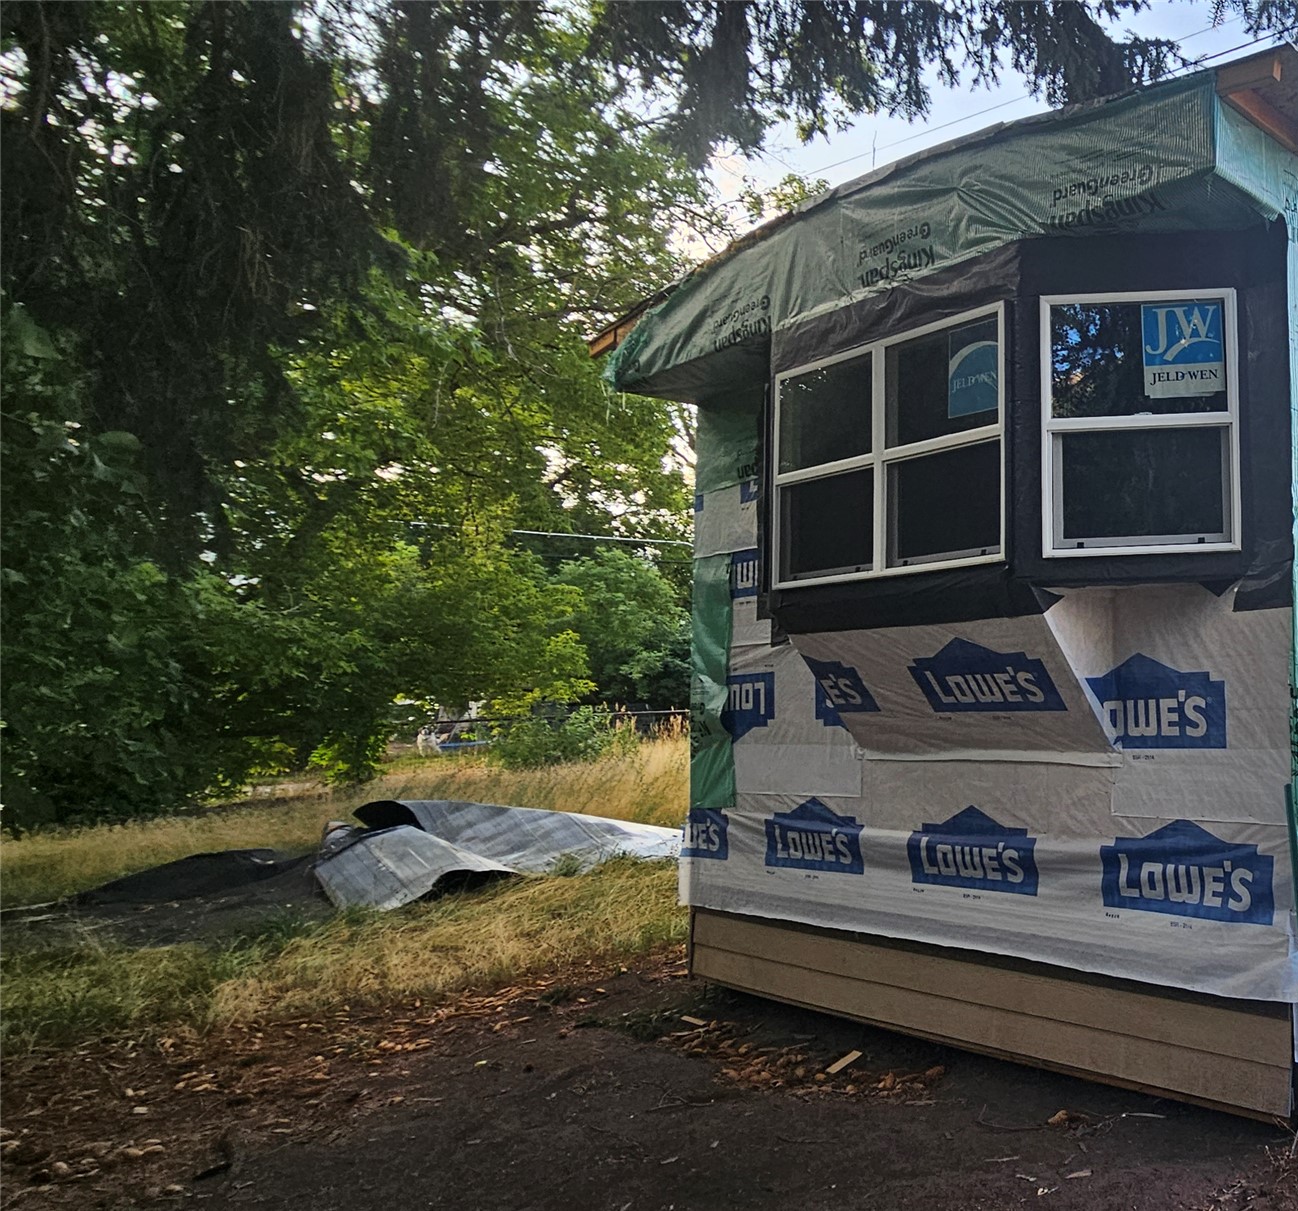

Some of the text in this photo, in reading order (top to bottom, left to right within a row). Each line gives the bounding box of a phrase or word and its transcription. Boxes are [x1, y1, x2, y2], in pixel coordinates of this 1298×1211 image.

[1051, 166, 1154, 209] GreenGuard
[1050, 194, 1165, 233] Kingspan
[858, 222, 932, 266] GreenGuard
[857, 247, 937, 289] Kingspan
[1145, 306, 1217, 355] JW
[924, 666, 1045, 704] LOWE'S
[1103, 690, 1208, 738] OWE'S
[773, 824, 852, 865] LOWE'S
[920, 836, 1025, 884] LOWE'S
[1118, 853, 1254, 912] LOWE'S
